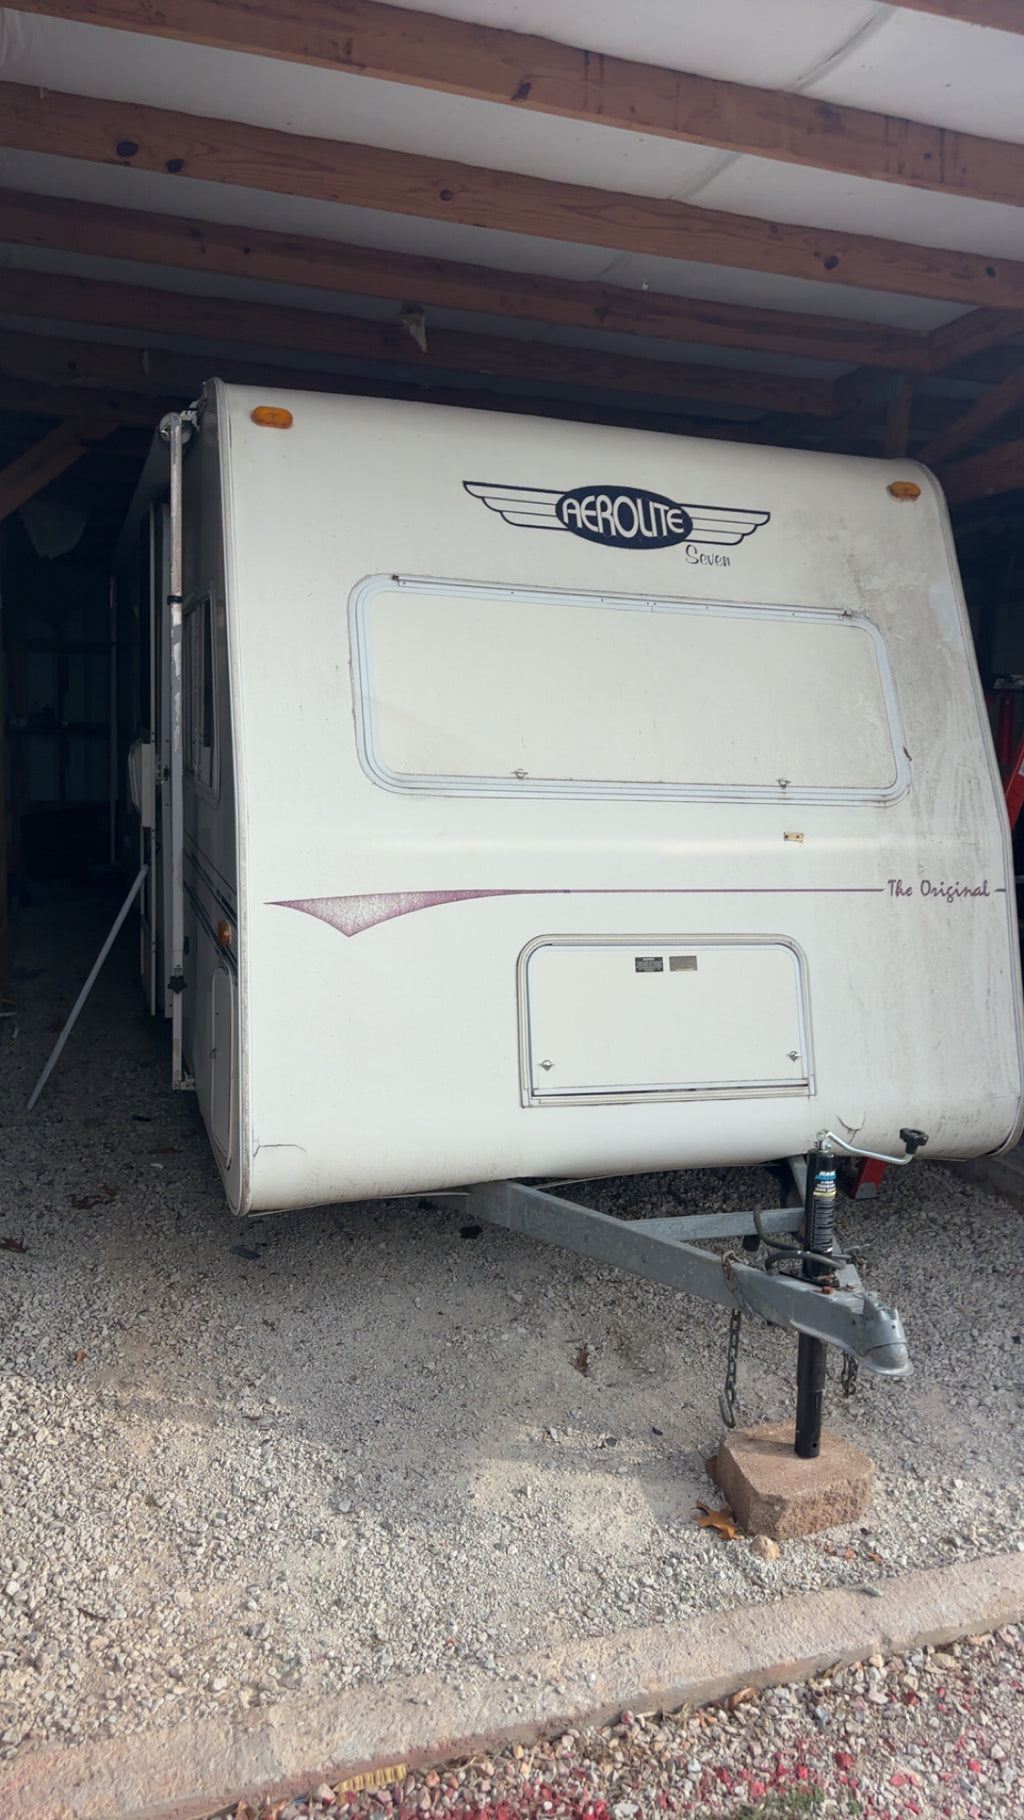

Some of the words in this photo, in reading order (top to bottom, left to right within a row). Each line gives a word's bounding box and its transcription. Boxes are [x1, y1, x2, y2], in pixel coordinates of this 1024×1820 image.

[562, 494, 686, 539] AEROLITE
[685, 544, 731, 568] Seven
[887, 879, 913, 897] The
[920, 879, 991, 903] Original
